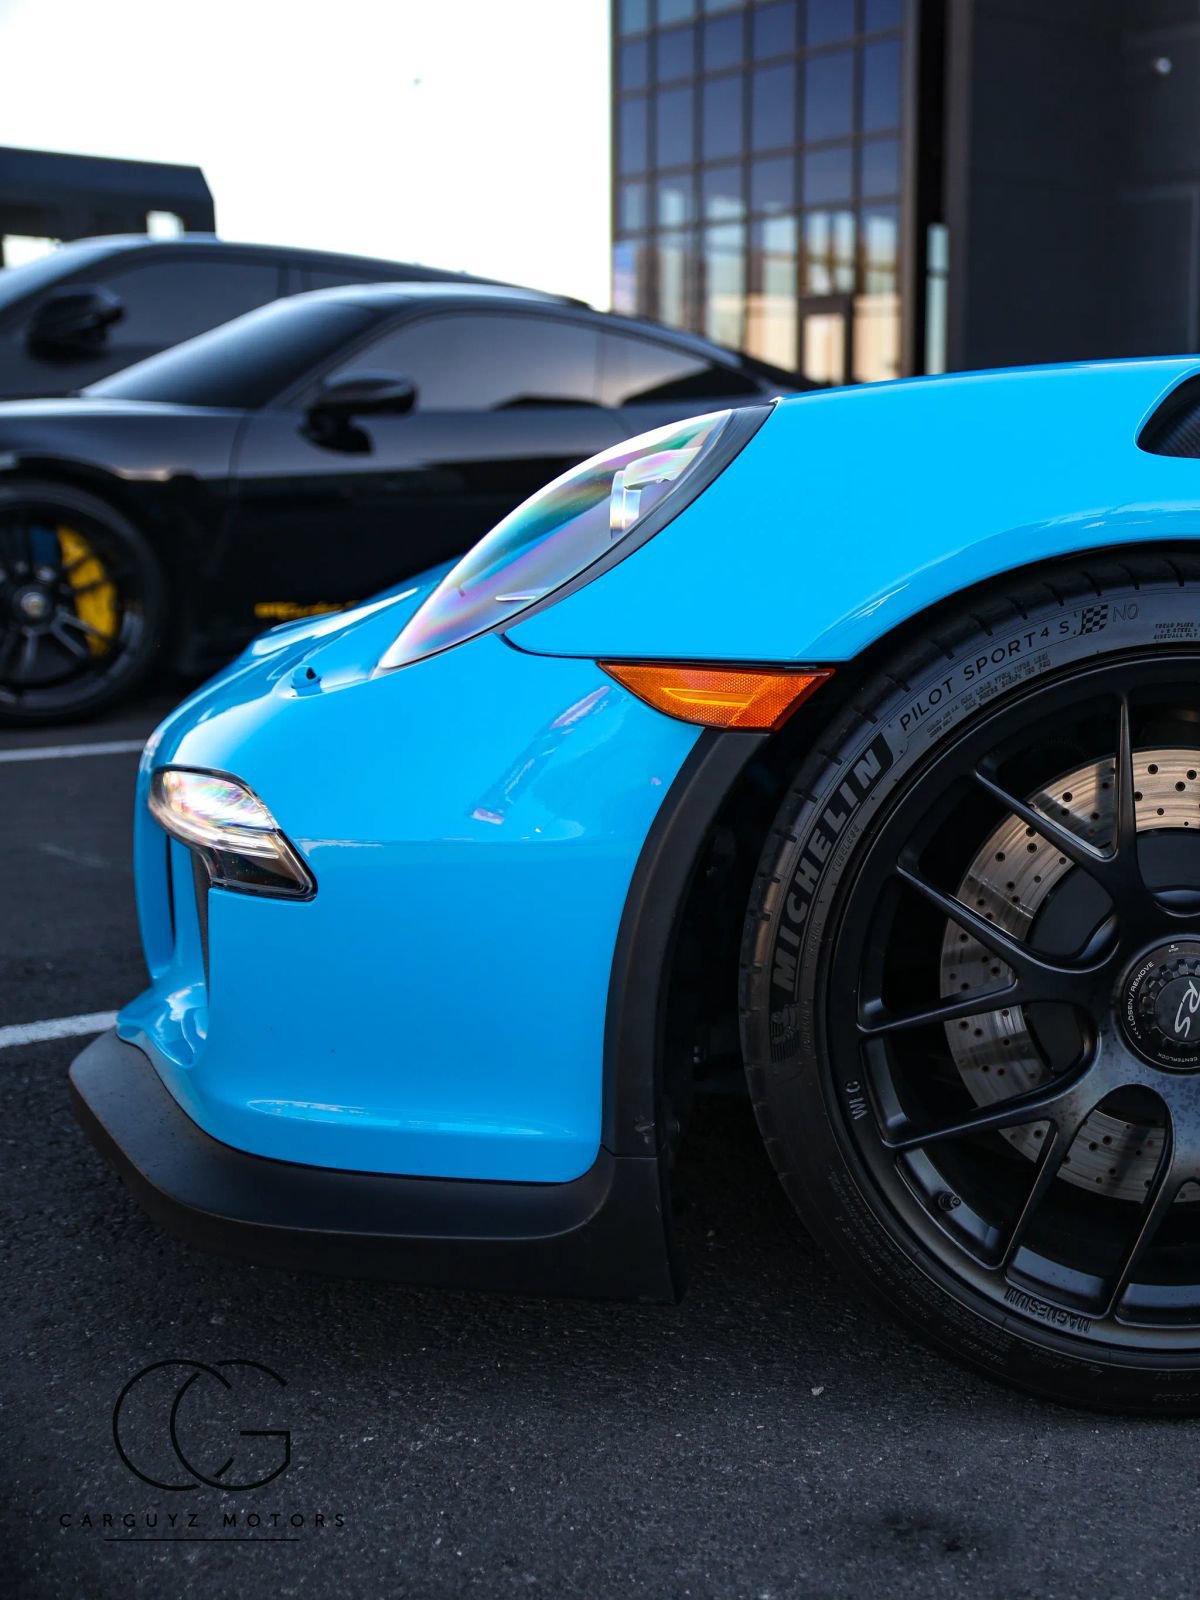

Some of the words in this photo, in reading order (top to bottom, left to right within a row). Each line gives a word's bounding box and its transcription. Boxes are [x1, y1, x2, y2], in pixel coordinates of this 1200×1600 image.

[899, 677, 954, 731] PILOT
[963, 632, 1037, 681] SPORT
[1040, 627, 1049, 638] 4
[1059, 620, 1070, 634] S
[772, 748, 884, 993] MICHELIN
[1131, 961, 1155, 992] REMOVE
[1004, 1285, 1092, 1334] MAGNESIUM
